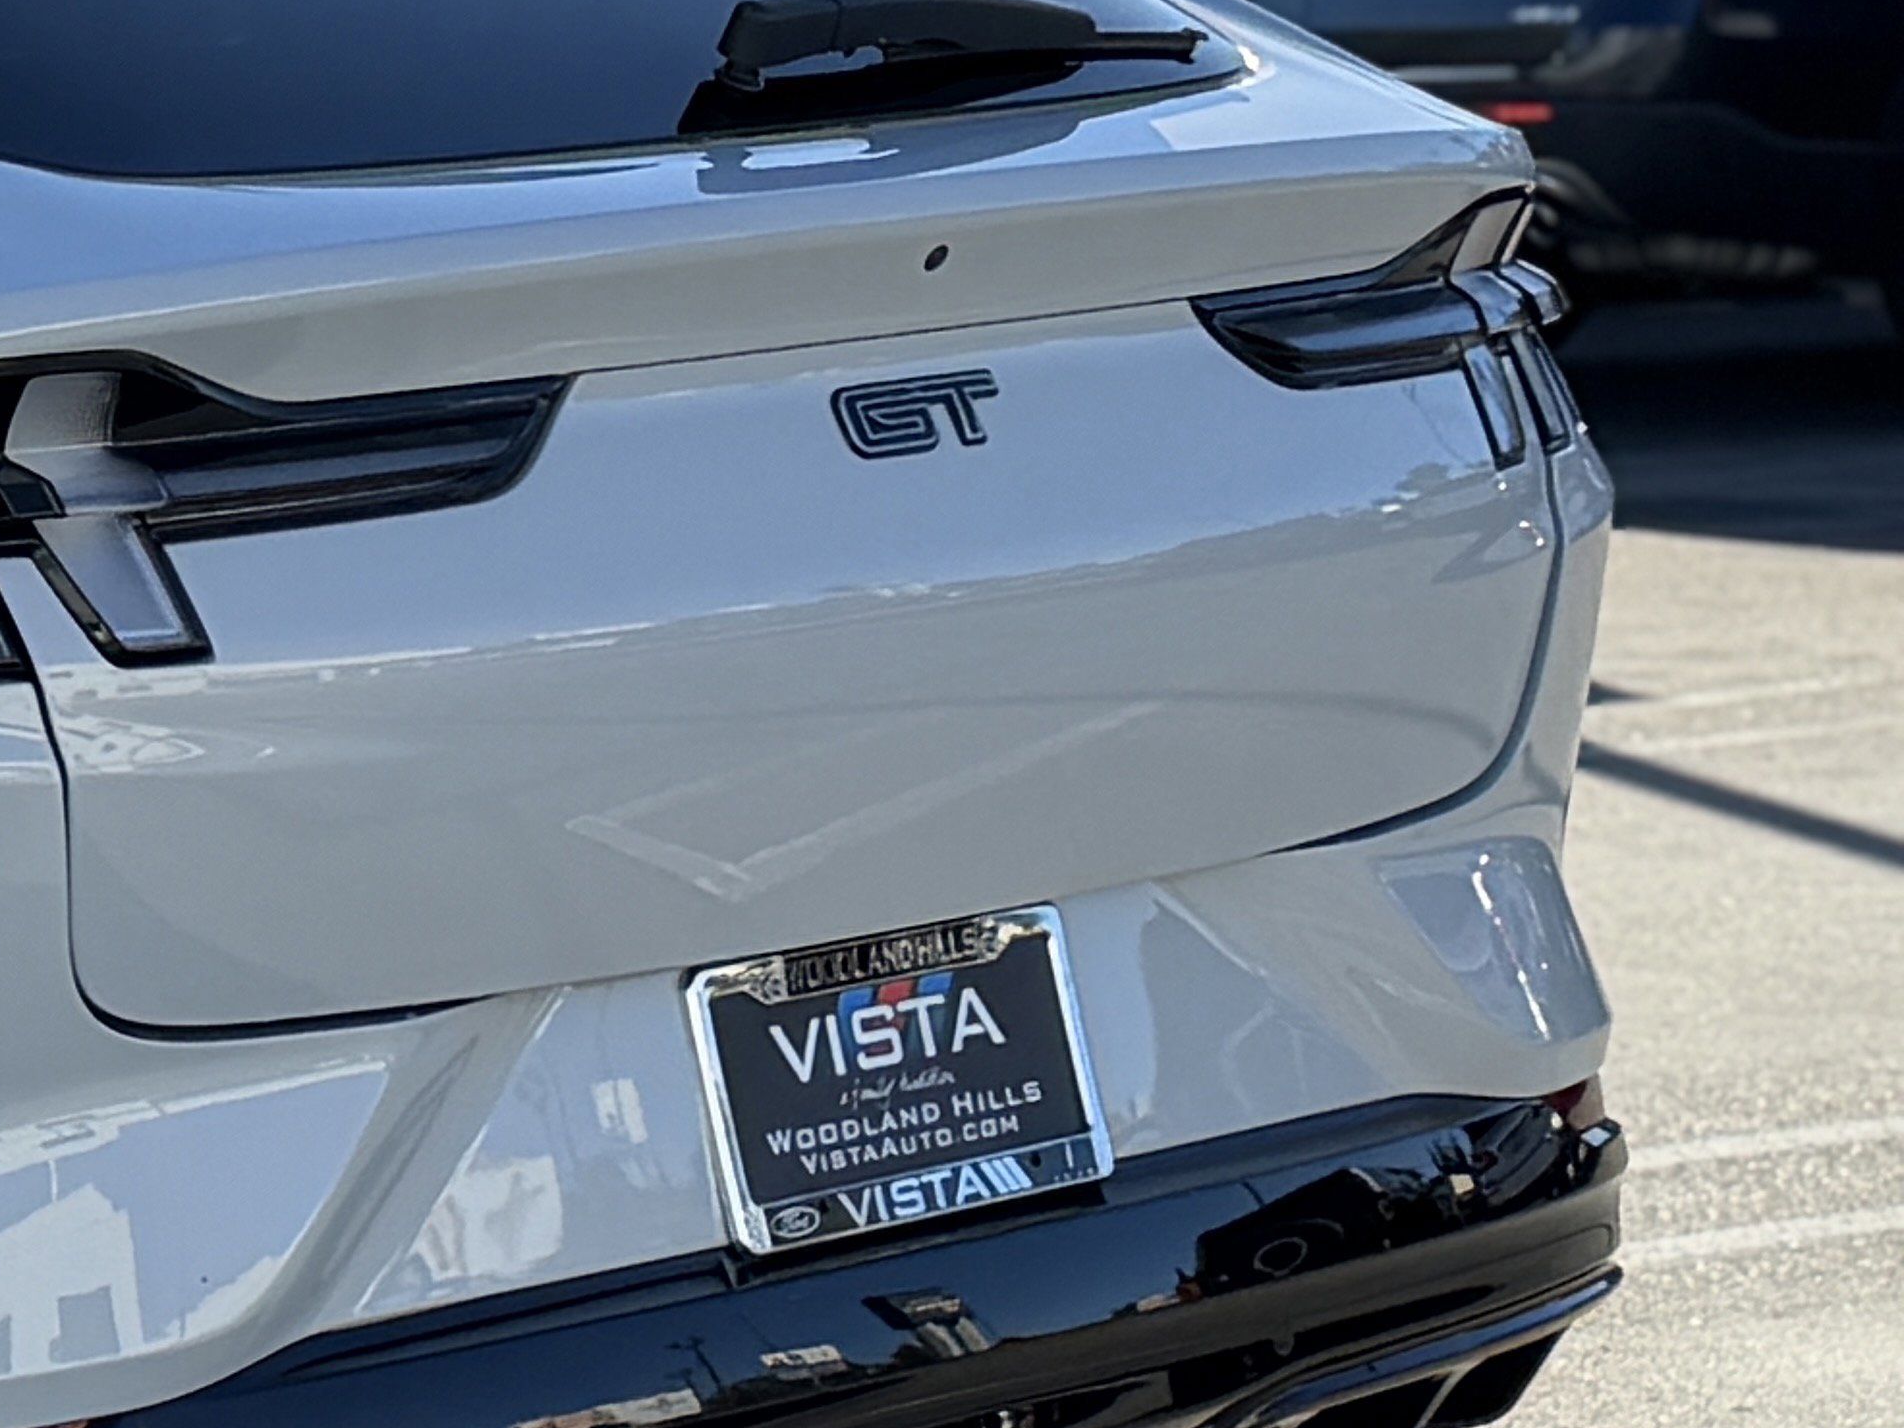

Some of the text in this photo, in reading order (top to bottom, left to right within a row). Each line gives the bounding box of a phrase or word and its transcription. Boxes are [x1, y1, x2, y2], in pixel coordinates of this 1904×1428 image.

[830, 368, 999, 460] GT
[768, 986, 1007, 1083] VISTA
[765, 1101, 941, 1156] WOODLAND
[951, 1080, 1042, 1118] HILLS
[799, 1114, 1020, 1175] VISTAAUTO.COM
[837, 1165, 992, 1228] VISTA
